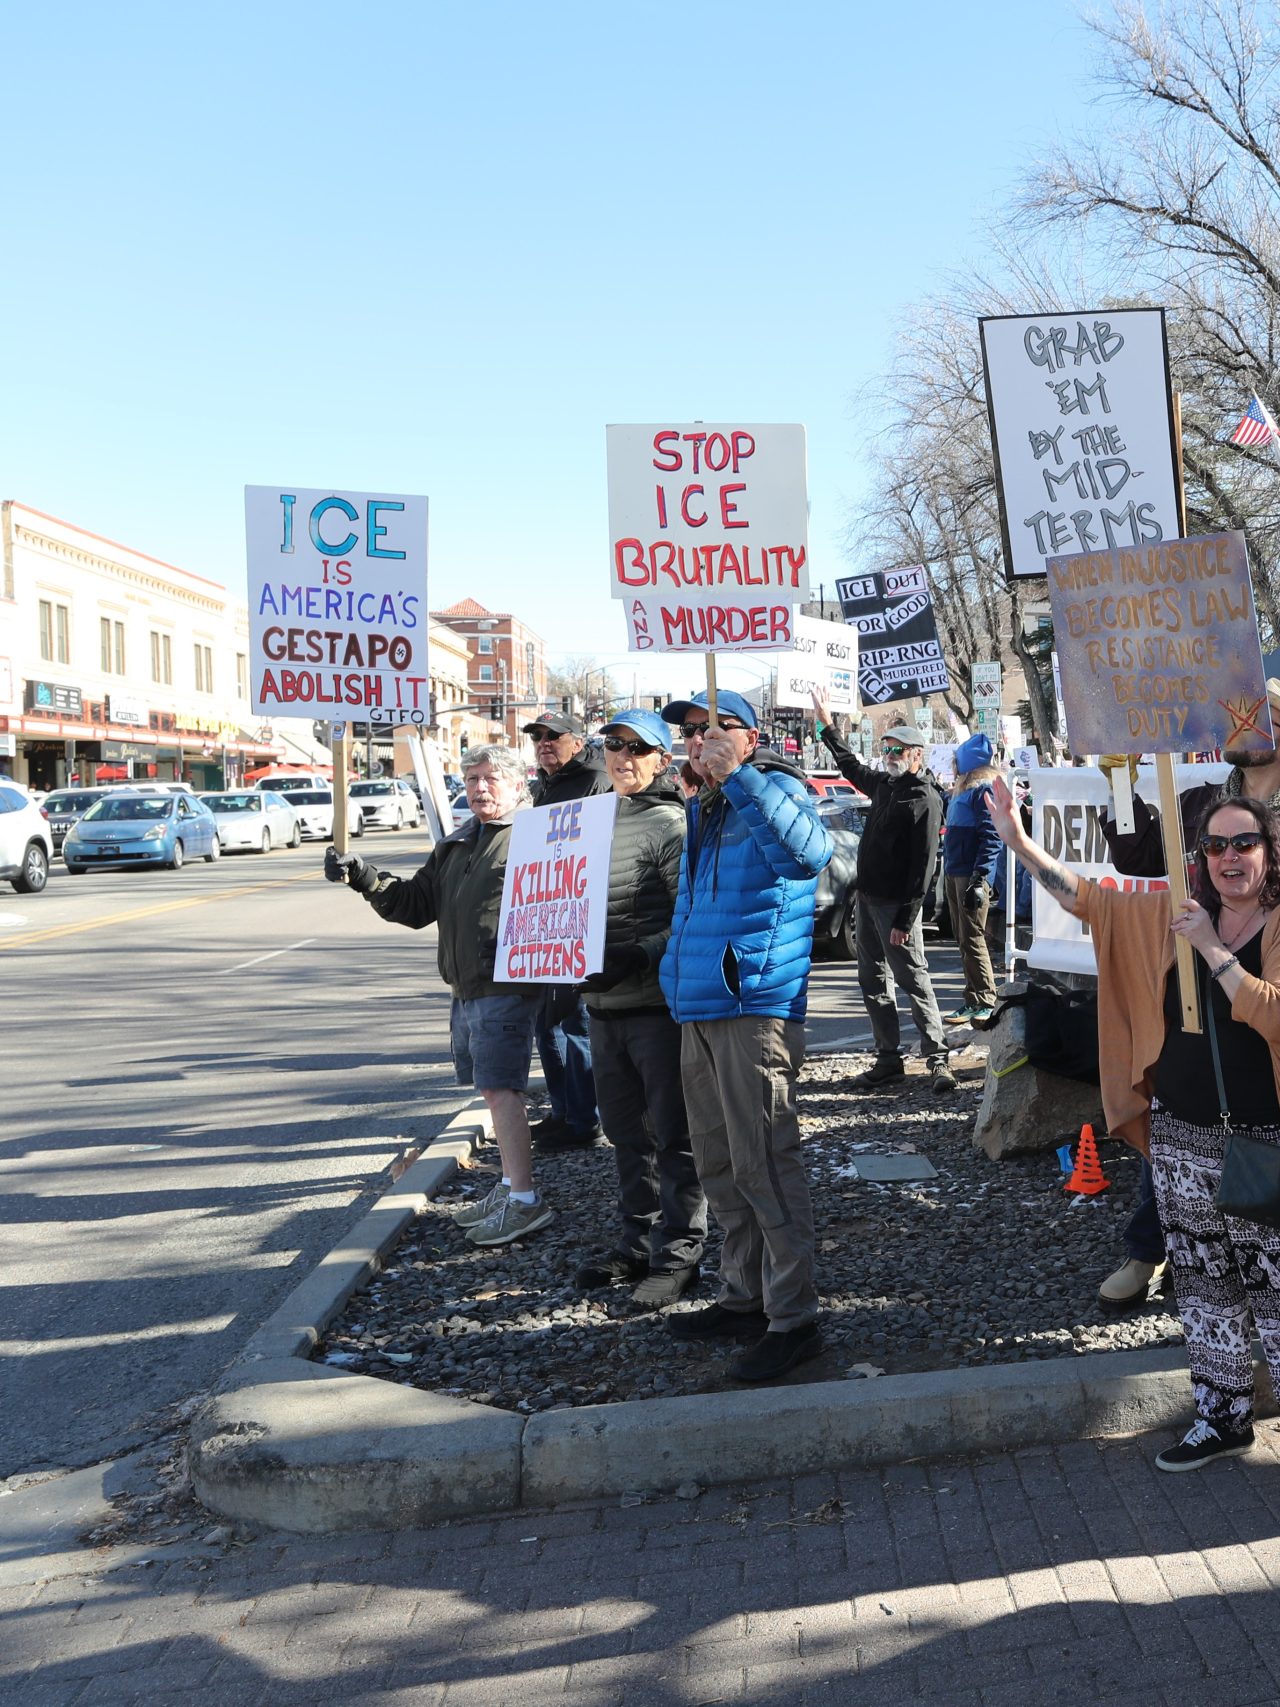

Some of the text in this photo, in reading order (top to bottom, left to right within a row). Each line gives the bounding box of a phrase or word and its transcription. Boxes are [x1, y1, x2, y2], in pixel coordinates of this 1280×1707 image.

[1024, 321, 1124, 374] GRAB
[1045, 372, 1111, 415] 'EM
[652, 430, 756, 474] STOP
[1028, 424, 1127, 465] BY THE
[1043, 458, 1145, 502] MID-
[656, 483, 749, 529] ICE
[280, 494, 406, 560] ICE
[1024, 500, 1163, 554] TERMS
[322, 559, 352, 585] IS
[615, 537, 806, 588] BRUTALITY
[1052, 538, 1232, 592] WHEN INJUSTICE
[259, 583, 419, 628] AMERICA'S
[841, 572, 920, 600] ICE OUT
[660, 605, 791, 645] MURDER
[889, 594, 929, 625] GOOD
[1064, 583, 1250, 640] BECOMES LAW
[262, 626, 412, 671] GESTAPO
[793, 637, 817, 654] ESIST
[826, 642, 851, 660] RESIST
[859, 642, 938, 668] RIP: RNG
[1084, 635, 1222, 674] RESISTANCE
[259, 669, 427, 708] ABOLISH IT
[790, 678, 816, 694] RESIST
[861, 663, 944, 702] ICE MURDERED
[920, 676, 948, 689] HER
[1111, 674, 1211, 705] BECOMES
[370, 707, 425, 725] GTFO
[979, 712, 984, 722] 2
[1126, 705, 1189, 738] DUTY
[546, 801, 583, 844] ICE
[511, 855, 587, 908] KILLING
[503, 898, 589, 946] AMERICAN
[507, 939, 586, 979] CITIZENS
